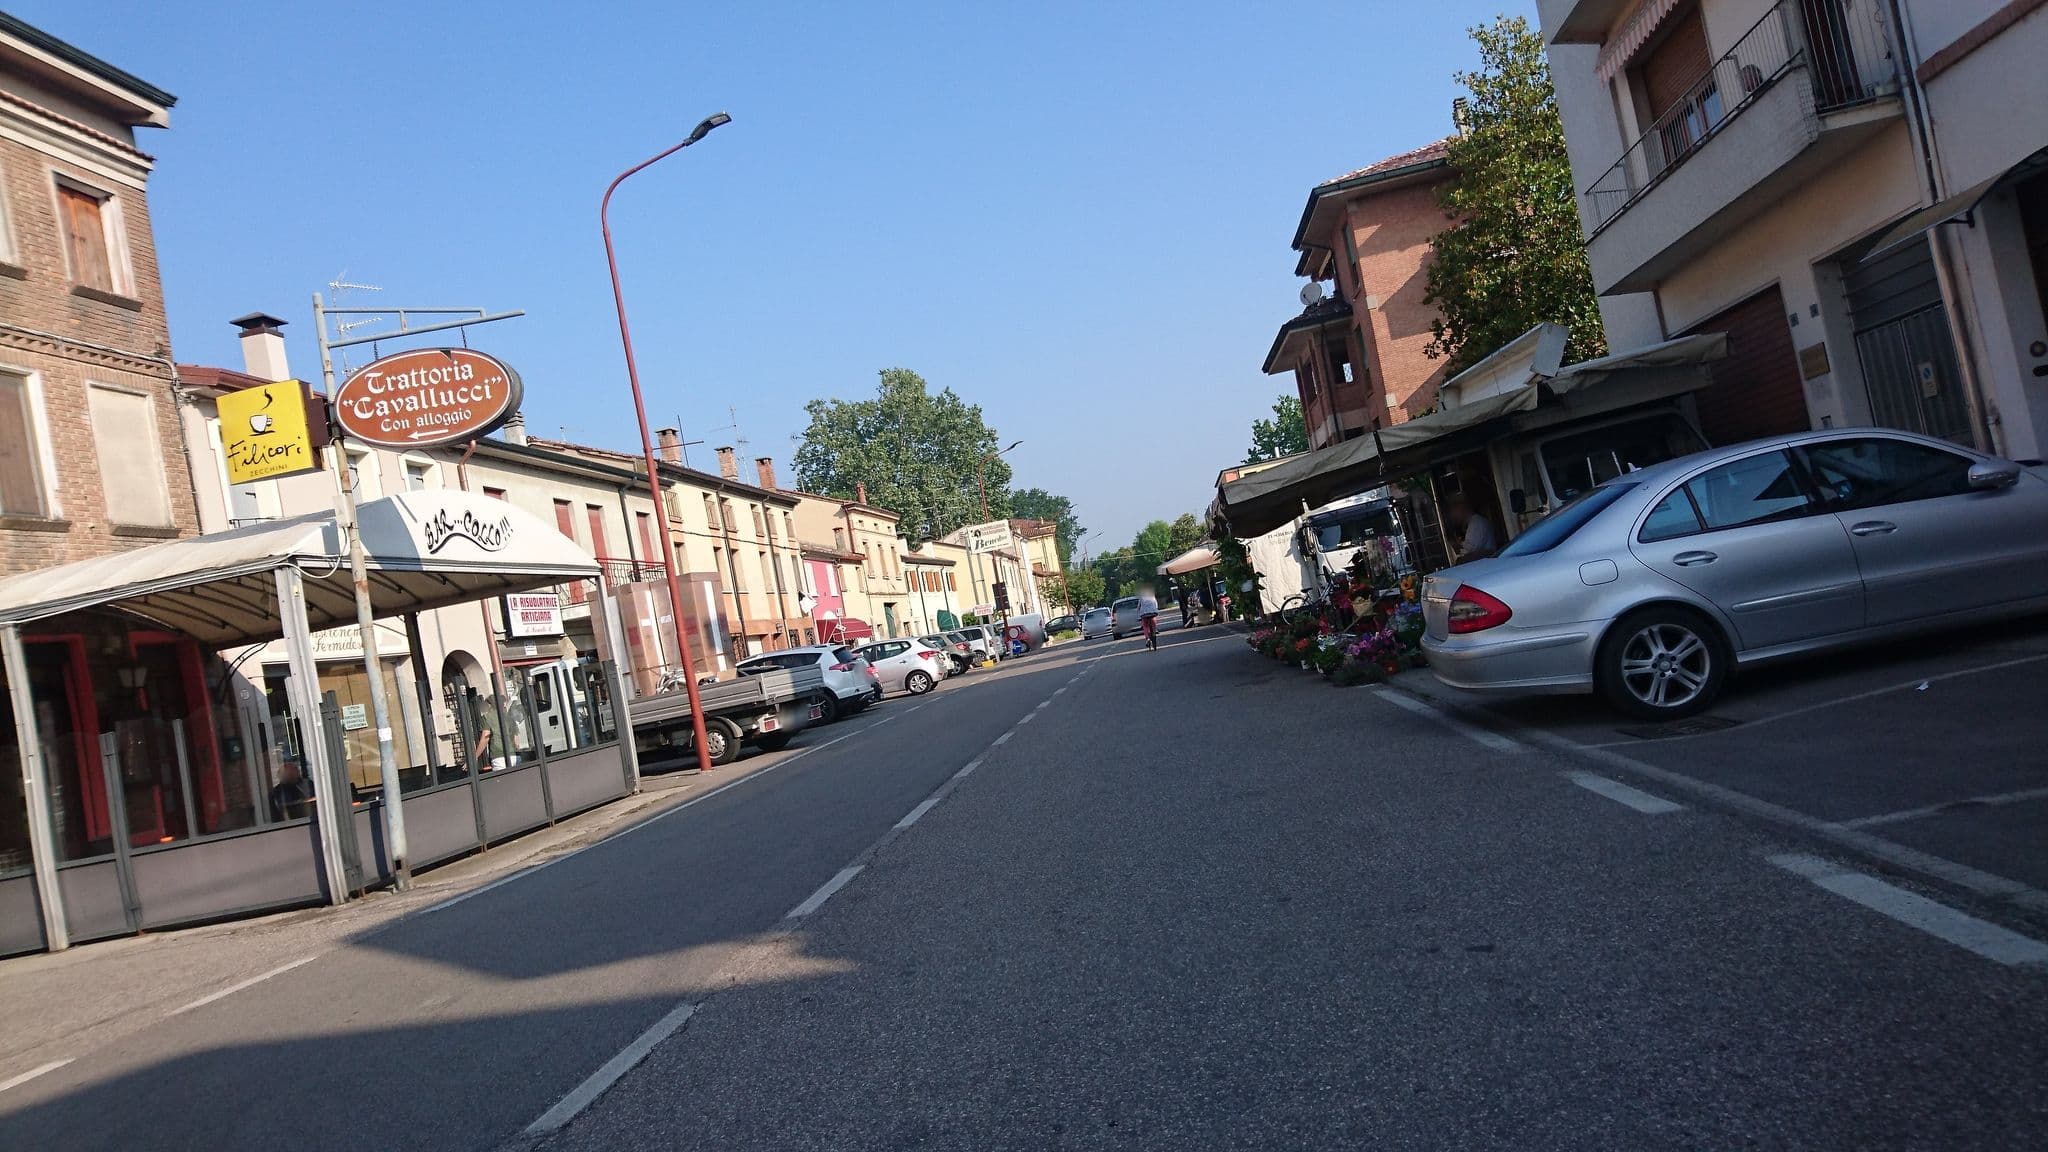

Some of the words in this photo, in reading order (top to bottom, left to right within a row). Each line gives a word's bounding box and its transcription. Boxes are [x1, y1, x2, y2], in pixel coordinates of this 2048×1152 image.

[365, 360, 474, 394] Trattoria
[381, 418, 410, 432] Con
[416, 408, 472, 428] alloggio
[228, 436, 302, 473] Filicori
[250, 464, 288, 477] ZECCHINI
[521, 610, 552, 622] ARTIGIANA
